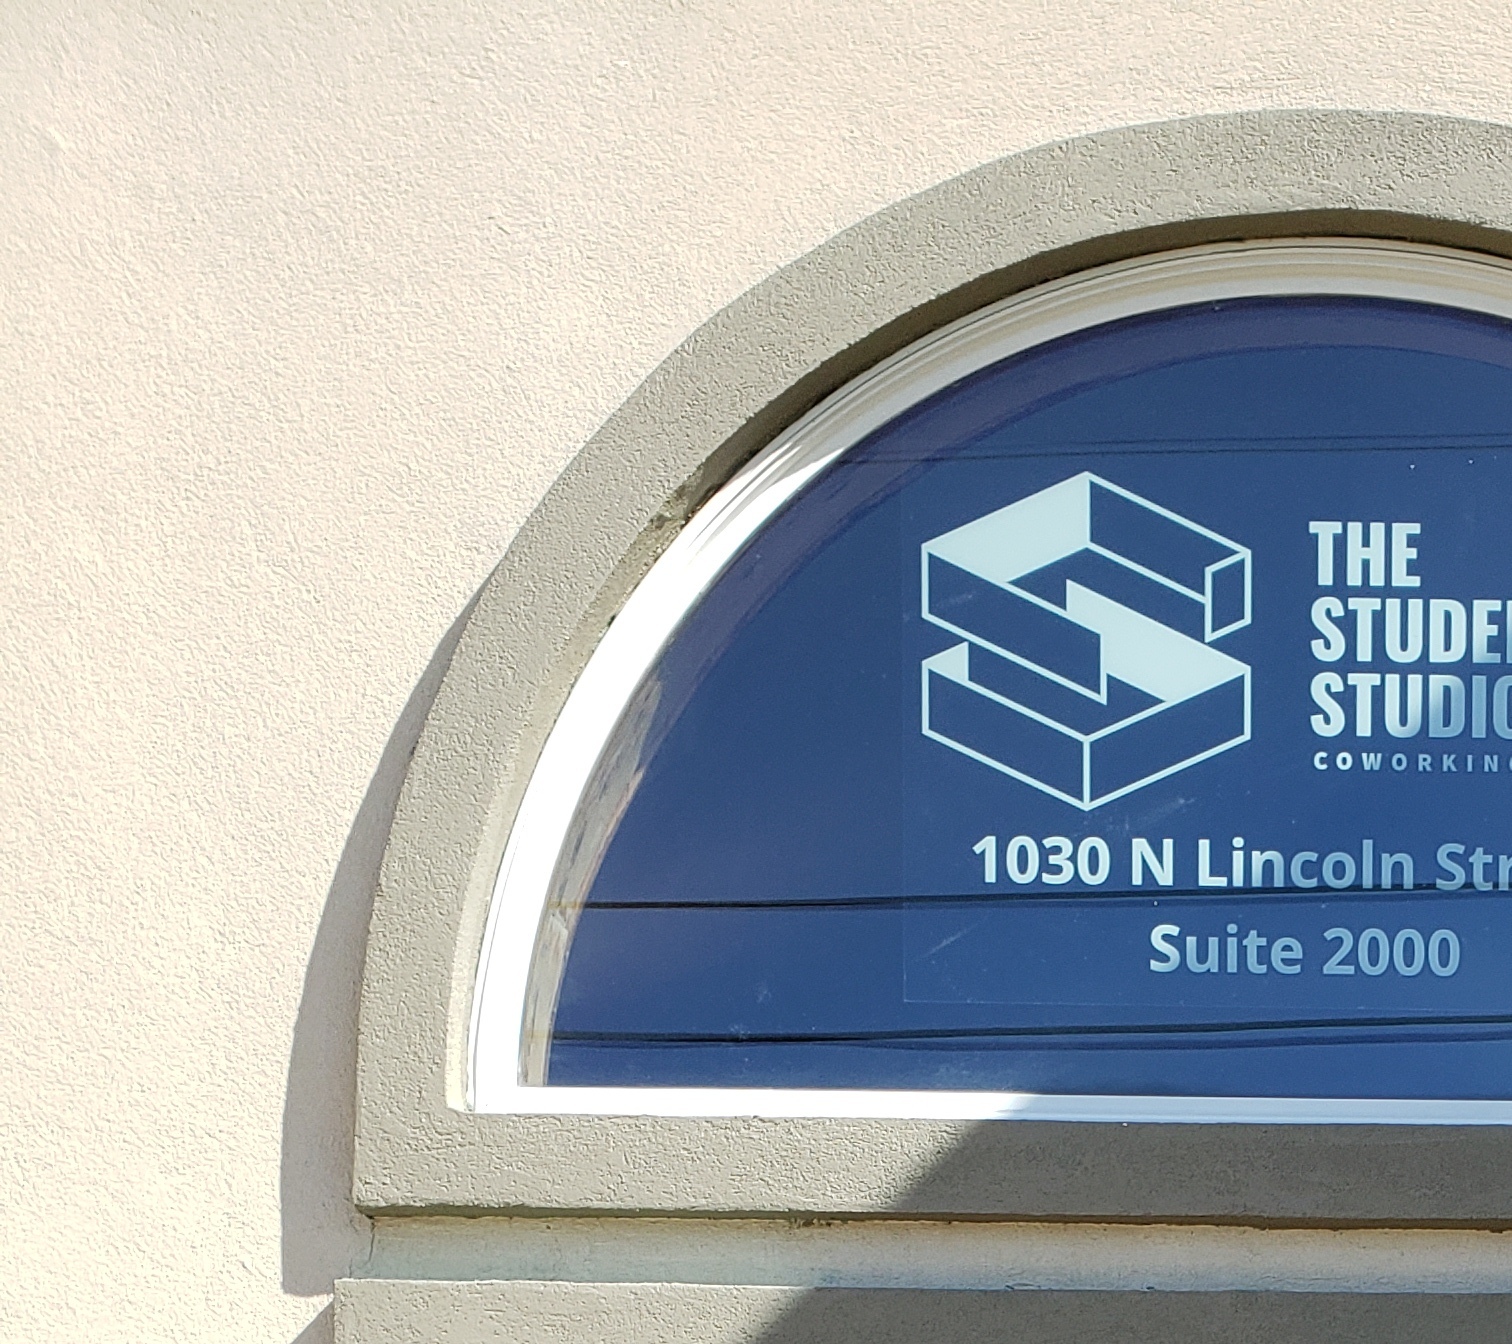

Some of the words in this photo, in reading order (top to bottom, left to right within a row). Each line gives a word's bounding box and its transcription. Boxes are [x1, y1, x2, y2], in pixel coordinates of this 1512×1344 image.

[1309, 521, 1421, 588] THE
[972, 836, 1111, 886] 1030
[1132, 838, 1173, 887] N
[1198, 838, 1415, 890] Lincoln
[1150, 924, 1303, 976] Suite
[1323, 928, 1461, 978] 2000
